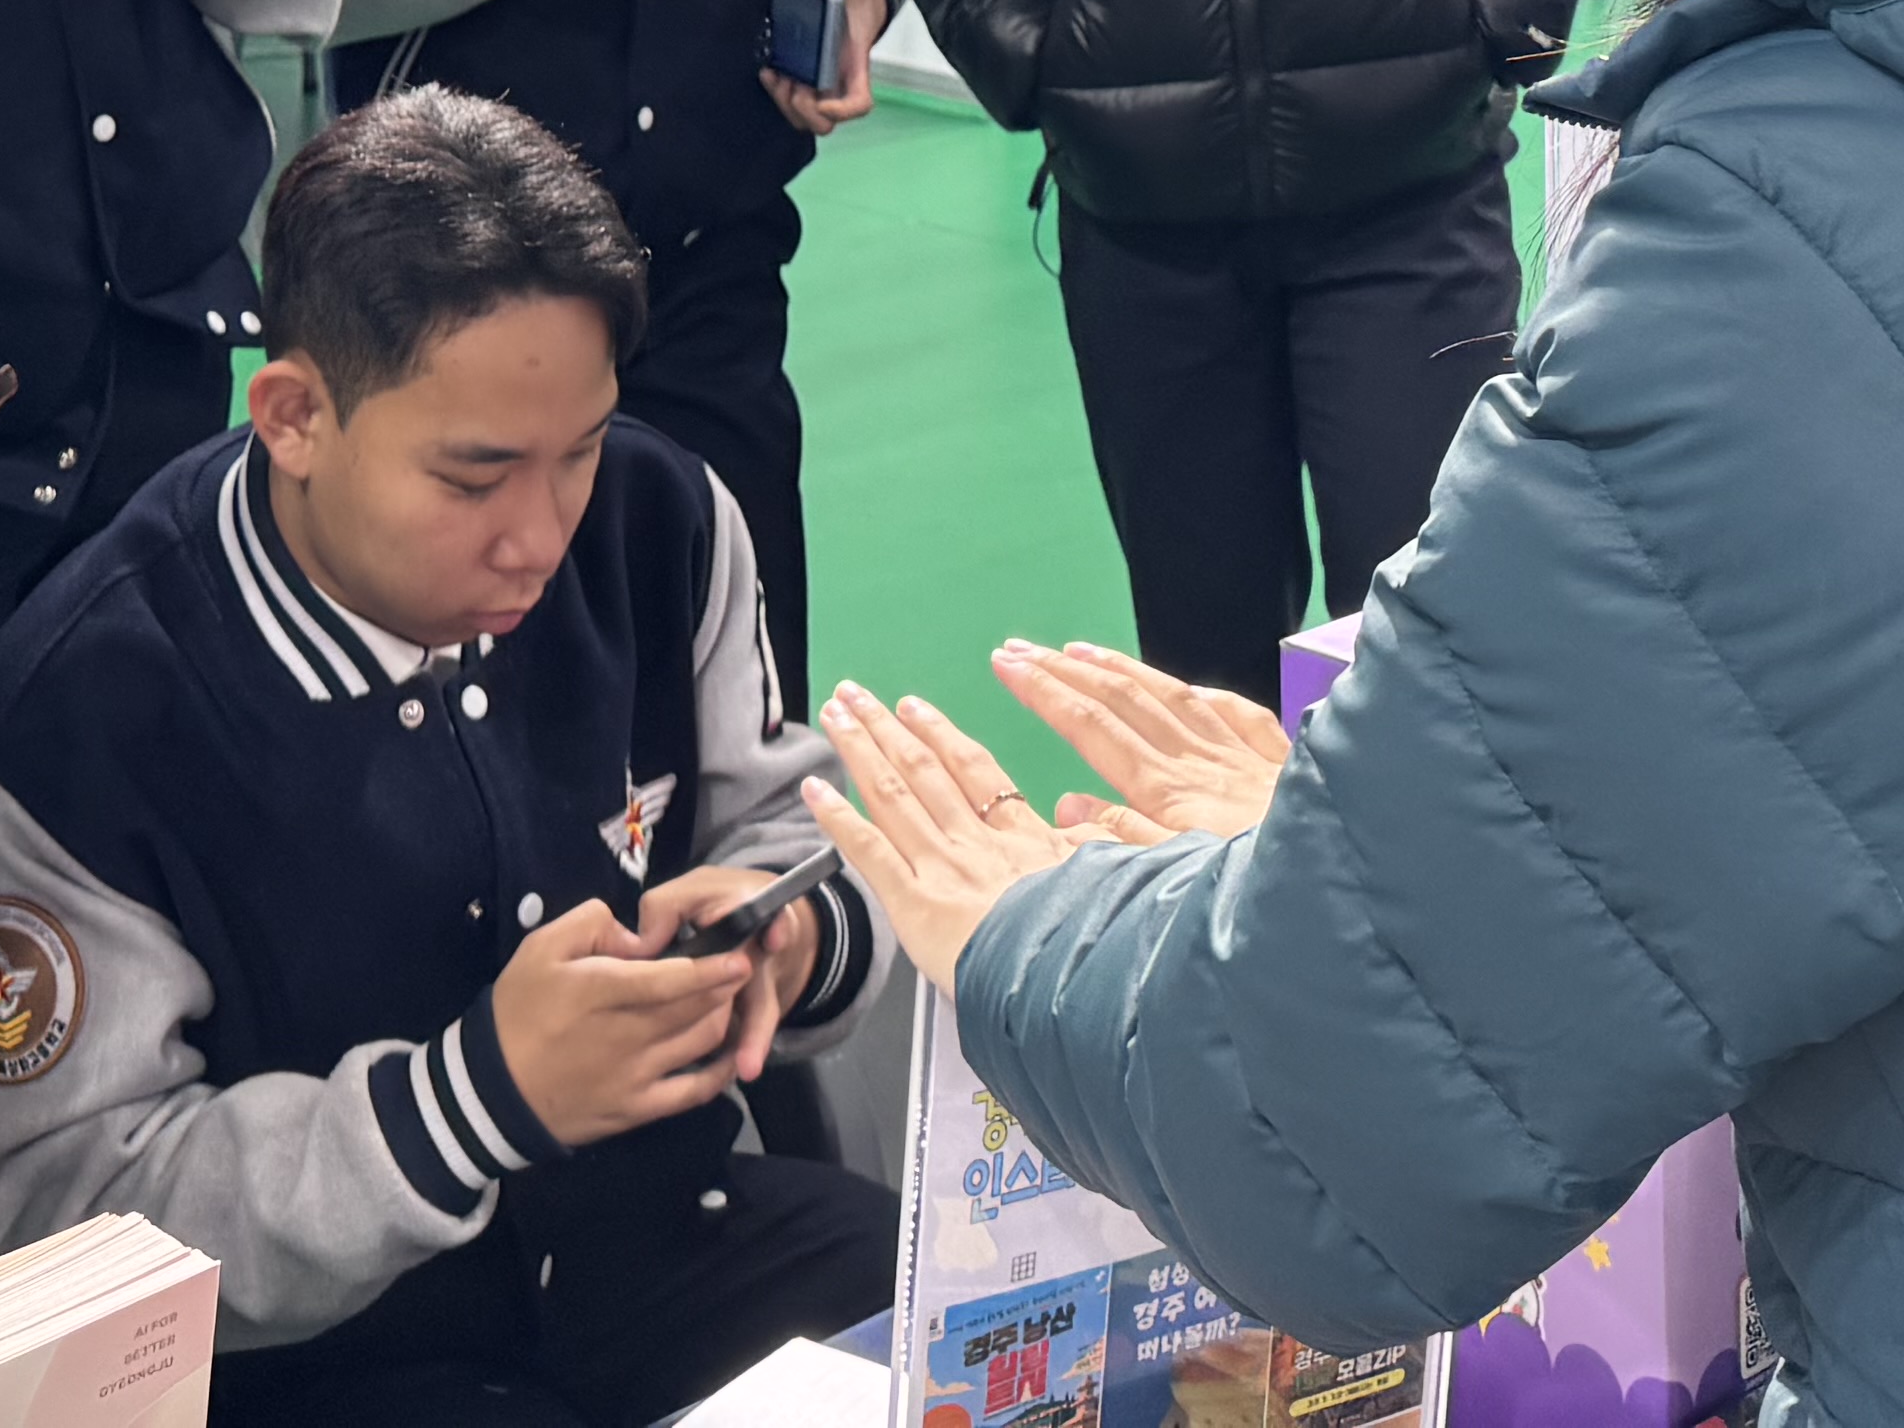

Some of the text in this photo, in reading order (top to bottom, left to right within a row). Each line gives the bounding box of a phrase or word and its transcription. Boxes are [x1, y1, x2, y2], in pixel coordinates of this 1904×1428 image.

[134, 1311, 178, 1340] AI FOR
[1133, 1291, 1186, 1331] 경주
[124, 1334, 176, 1365] BETTER
